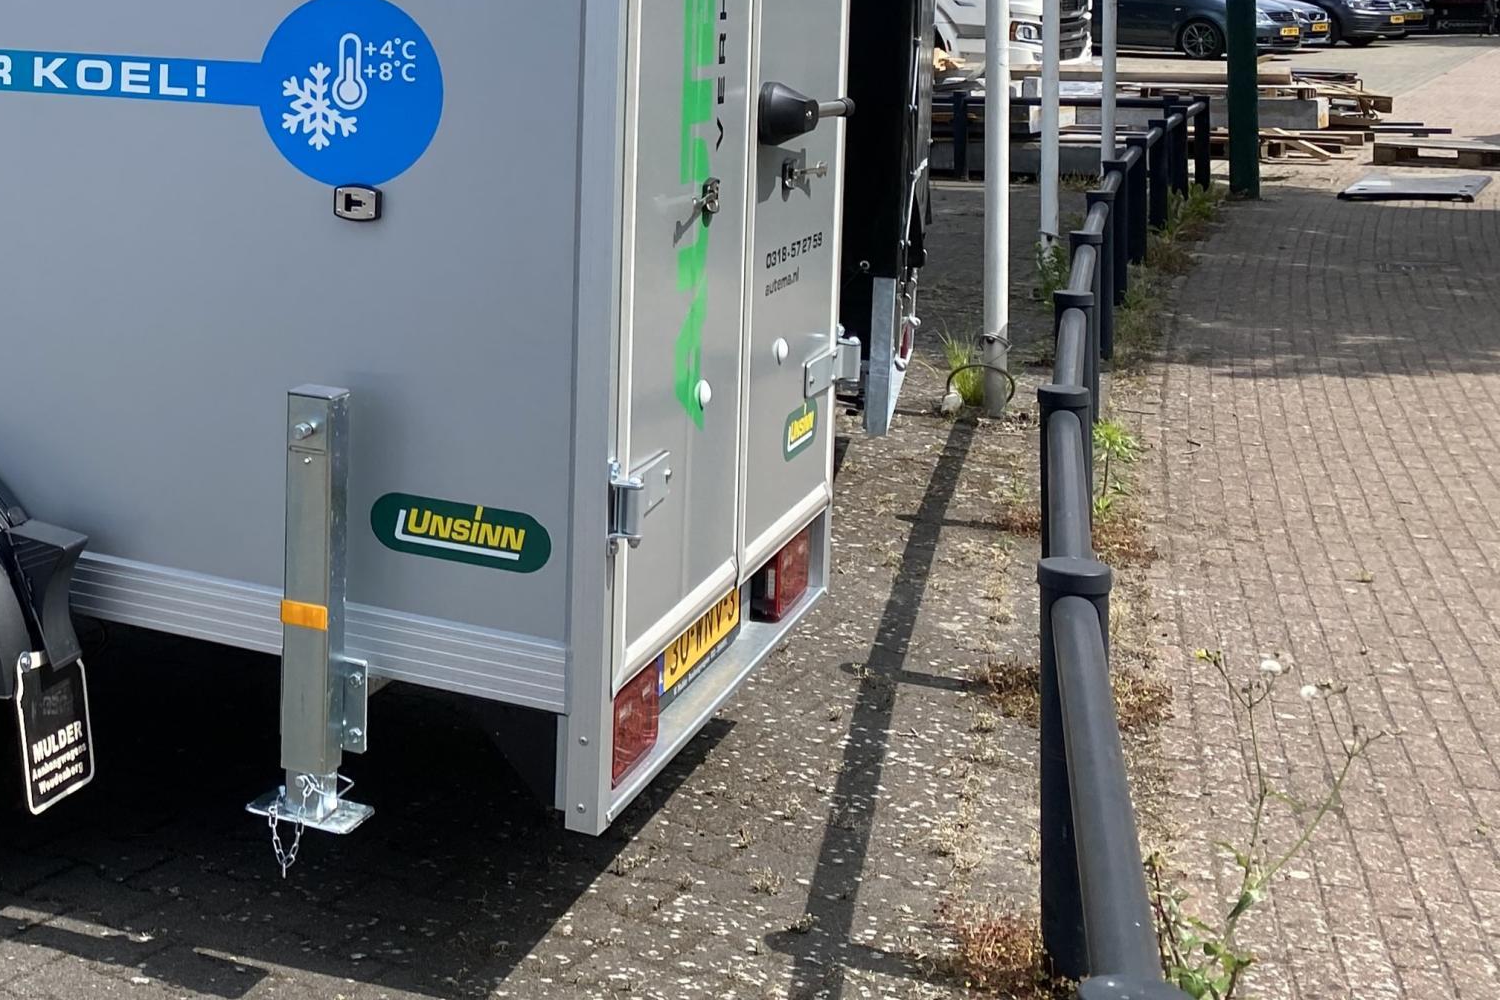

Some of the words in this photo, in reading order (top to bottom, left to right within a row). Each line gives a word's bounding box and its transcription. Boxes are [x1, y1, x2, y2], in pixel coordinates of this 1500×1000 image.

[364, 37, 416, 60] +4°C
[33, 56, 208, 98] KOEL!
[363, 60, 416, 82] +8°C
[32, 720, 83, 765] MULDER
